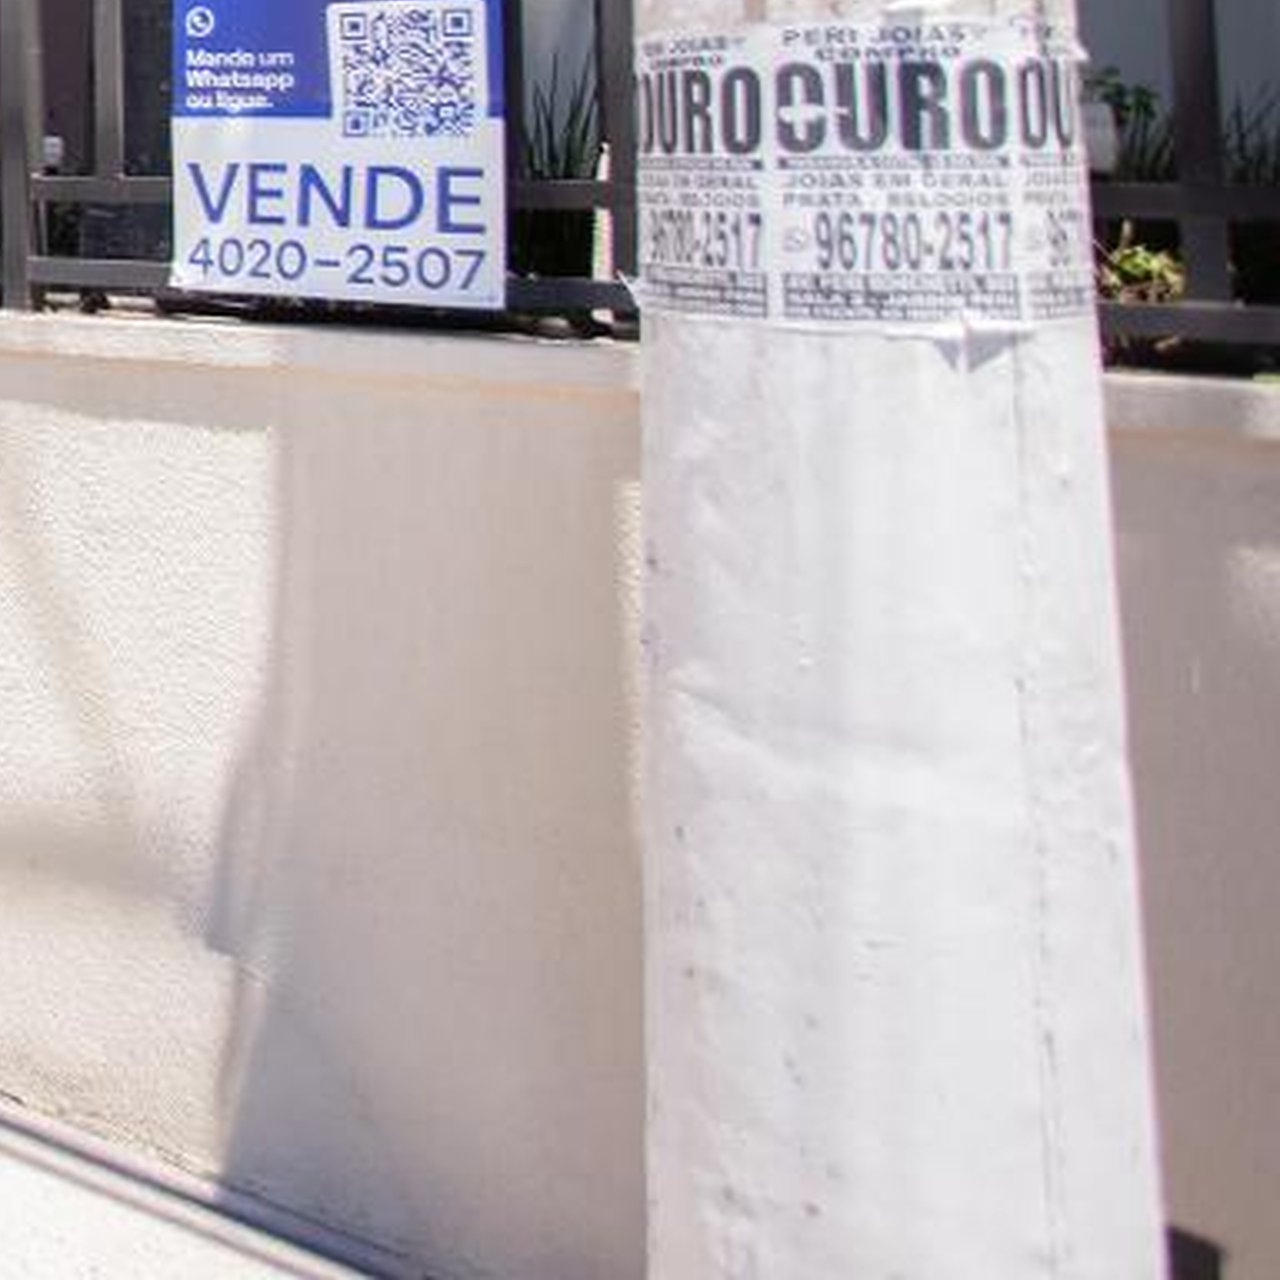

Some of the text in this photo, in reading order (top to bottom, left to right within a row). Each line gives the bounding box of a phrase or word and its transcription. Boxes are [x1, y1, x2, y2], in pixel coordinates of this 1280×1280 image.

[870, 21, 965, 44] JOIAS
[186, 69, 295, 91] Whatsapp
[186, 93, 213, 108] ou
[775, 60, 1008, 153] OURO
[187, 163, 487, 234] VENDE
[189, 238, 487, 290] 4020-2507
[815, 211, 1011, 271] 96780-2517
